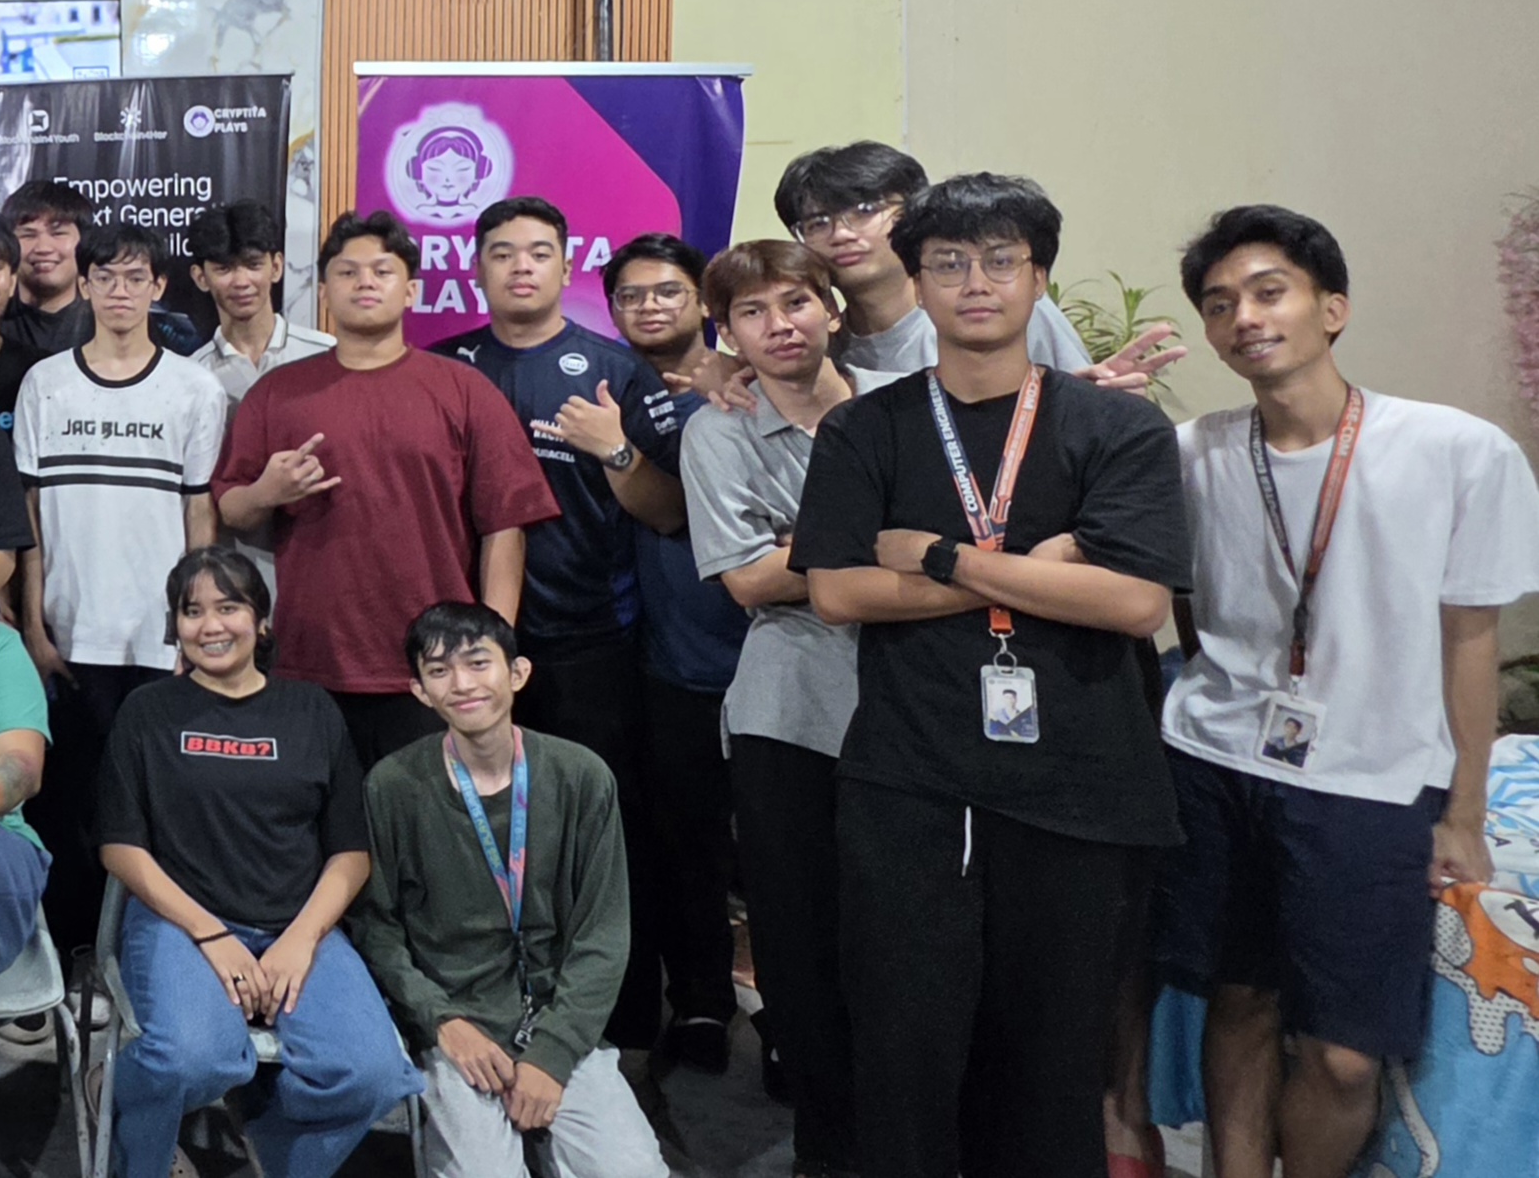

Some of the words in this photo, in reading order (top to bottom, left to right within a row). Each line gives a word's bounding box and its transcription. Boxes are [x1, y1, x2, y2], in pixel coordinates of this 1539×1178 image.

[213, 107, 267, 120] CRYPTITA
[213, 122, 248, 134] PLAYS
[411, 278, 490, 314] LAY
[101, 421, 165, 439] BLACK
[946, 440, 978, 512] COMPUTER
